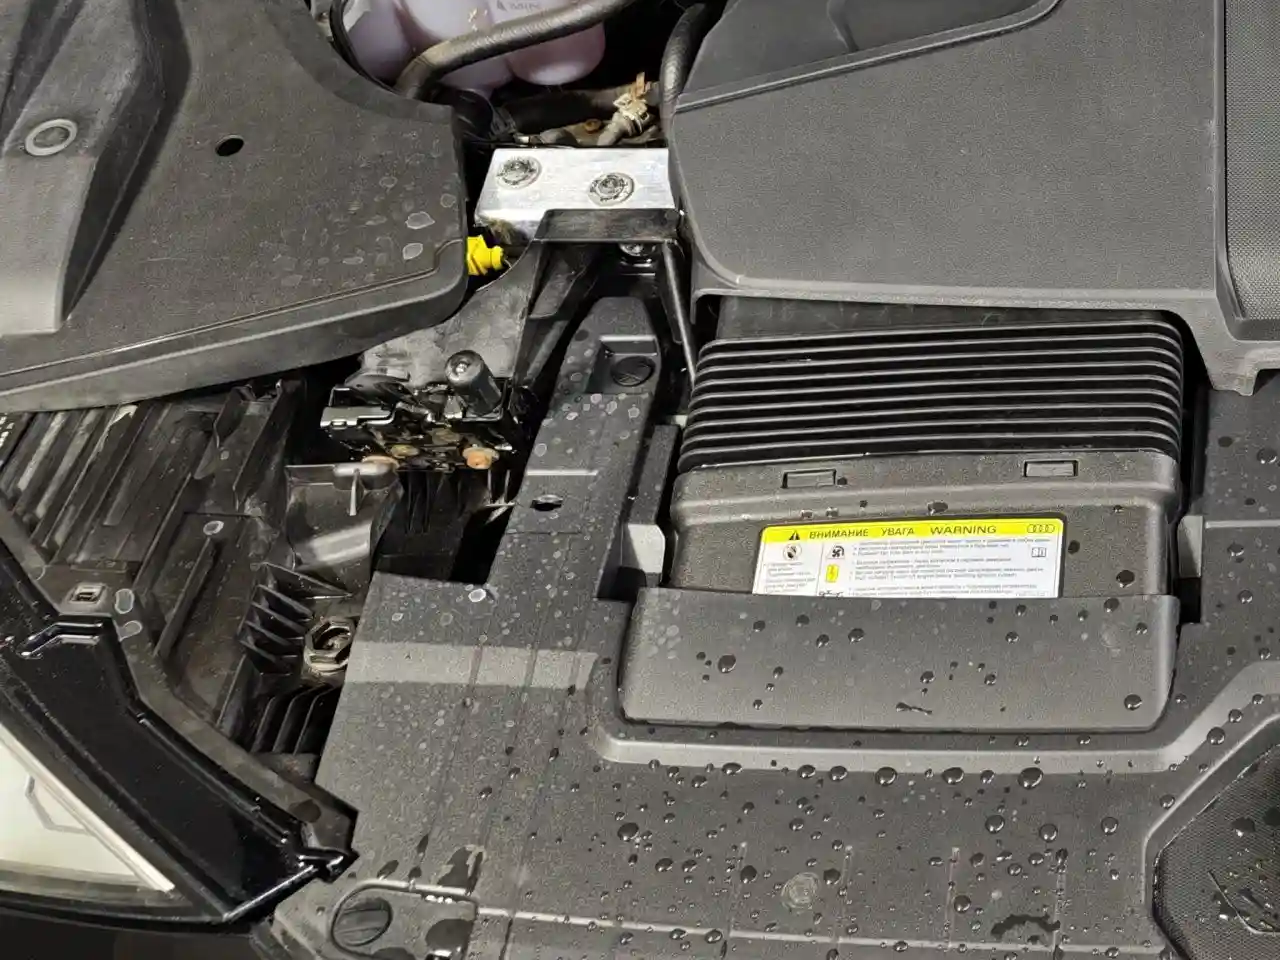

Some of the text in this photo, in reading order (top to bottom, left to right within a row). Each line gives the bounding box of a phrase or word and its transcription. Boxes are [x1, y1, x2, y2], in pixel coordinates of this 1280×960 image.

[809, 525, 997, 539] ВНИМАНИЕ УВАГА WARNING
